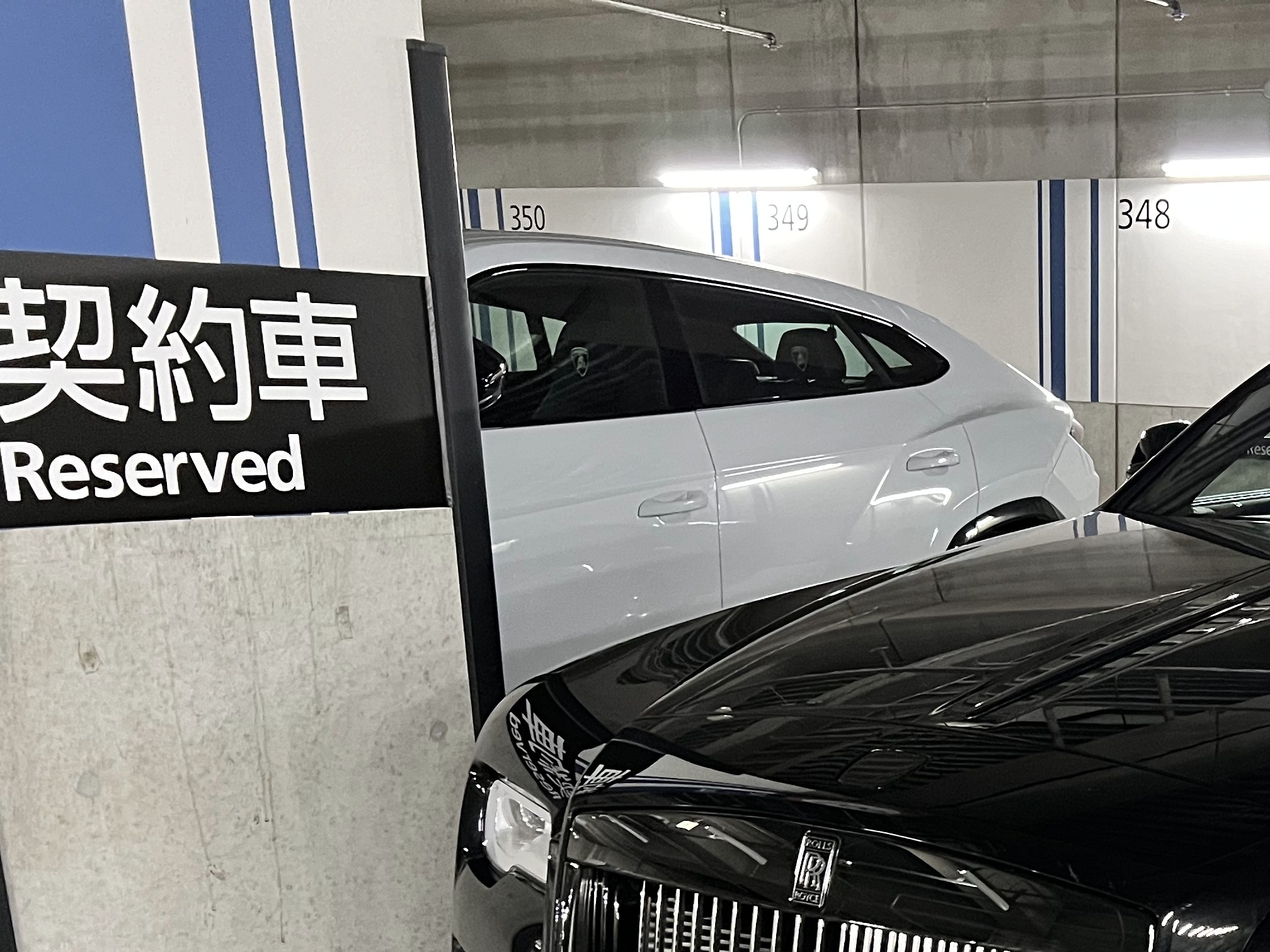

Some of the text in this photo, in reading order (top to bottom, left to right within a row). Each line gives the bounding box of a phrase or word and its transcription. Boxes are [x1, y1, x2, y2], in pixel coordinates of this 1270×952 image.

[510, 204, 546, 231] 350
[768, 203, 810, 232] 349
[1118, 198, 1171, 230] 348
[0, 278, 368, 423] 契約車
[0, 433, 306, 501] Reserved
